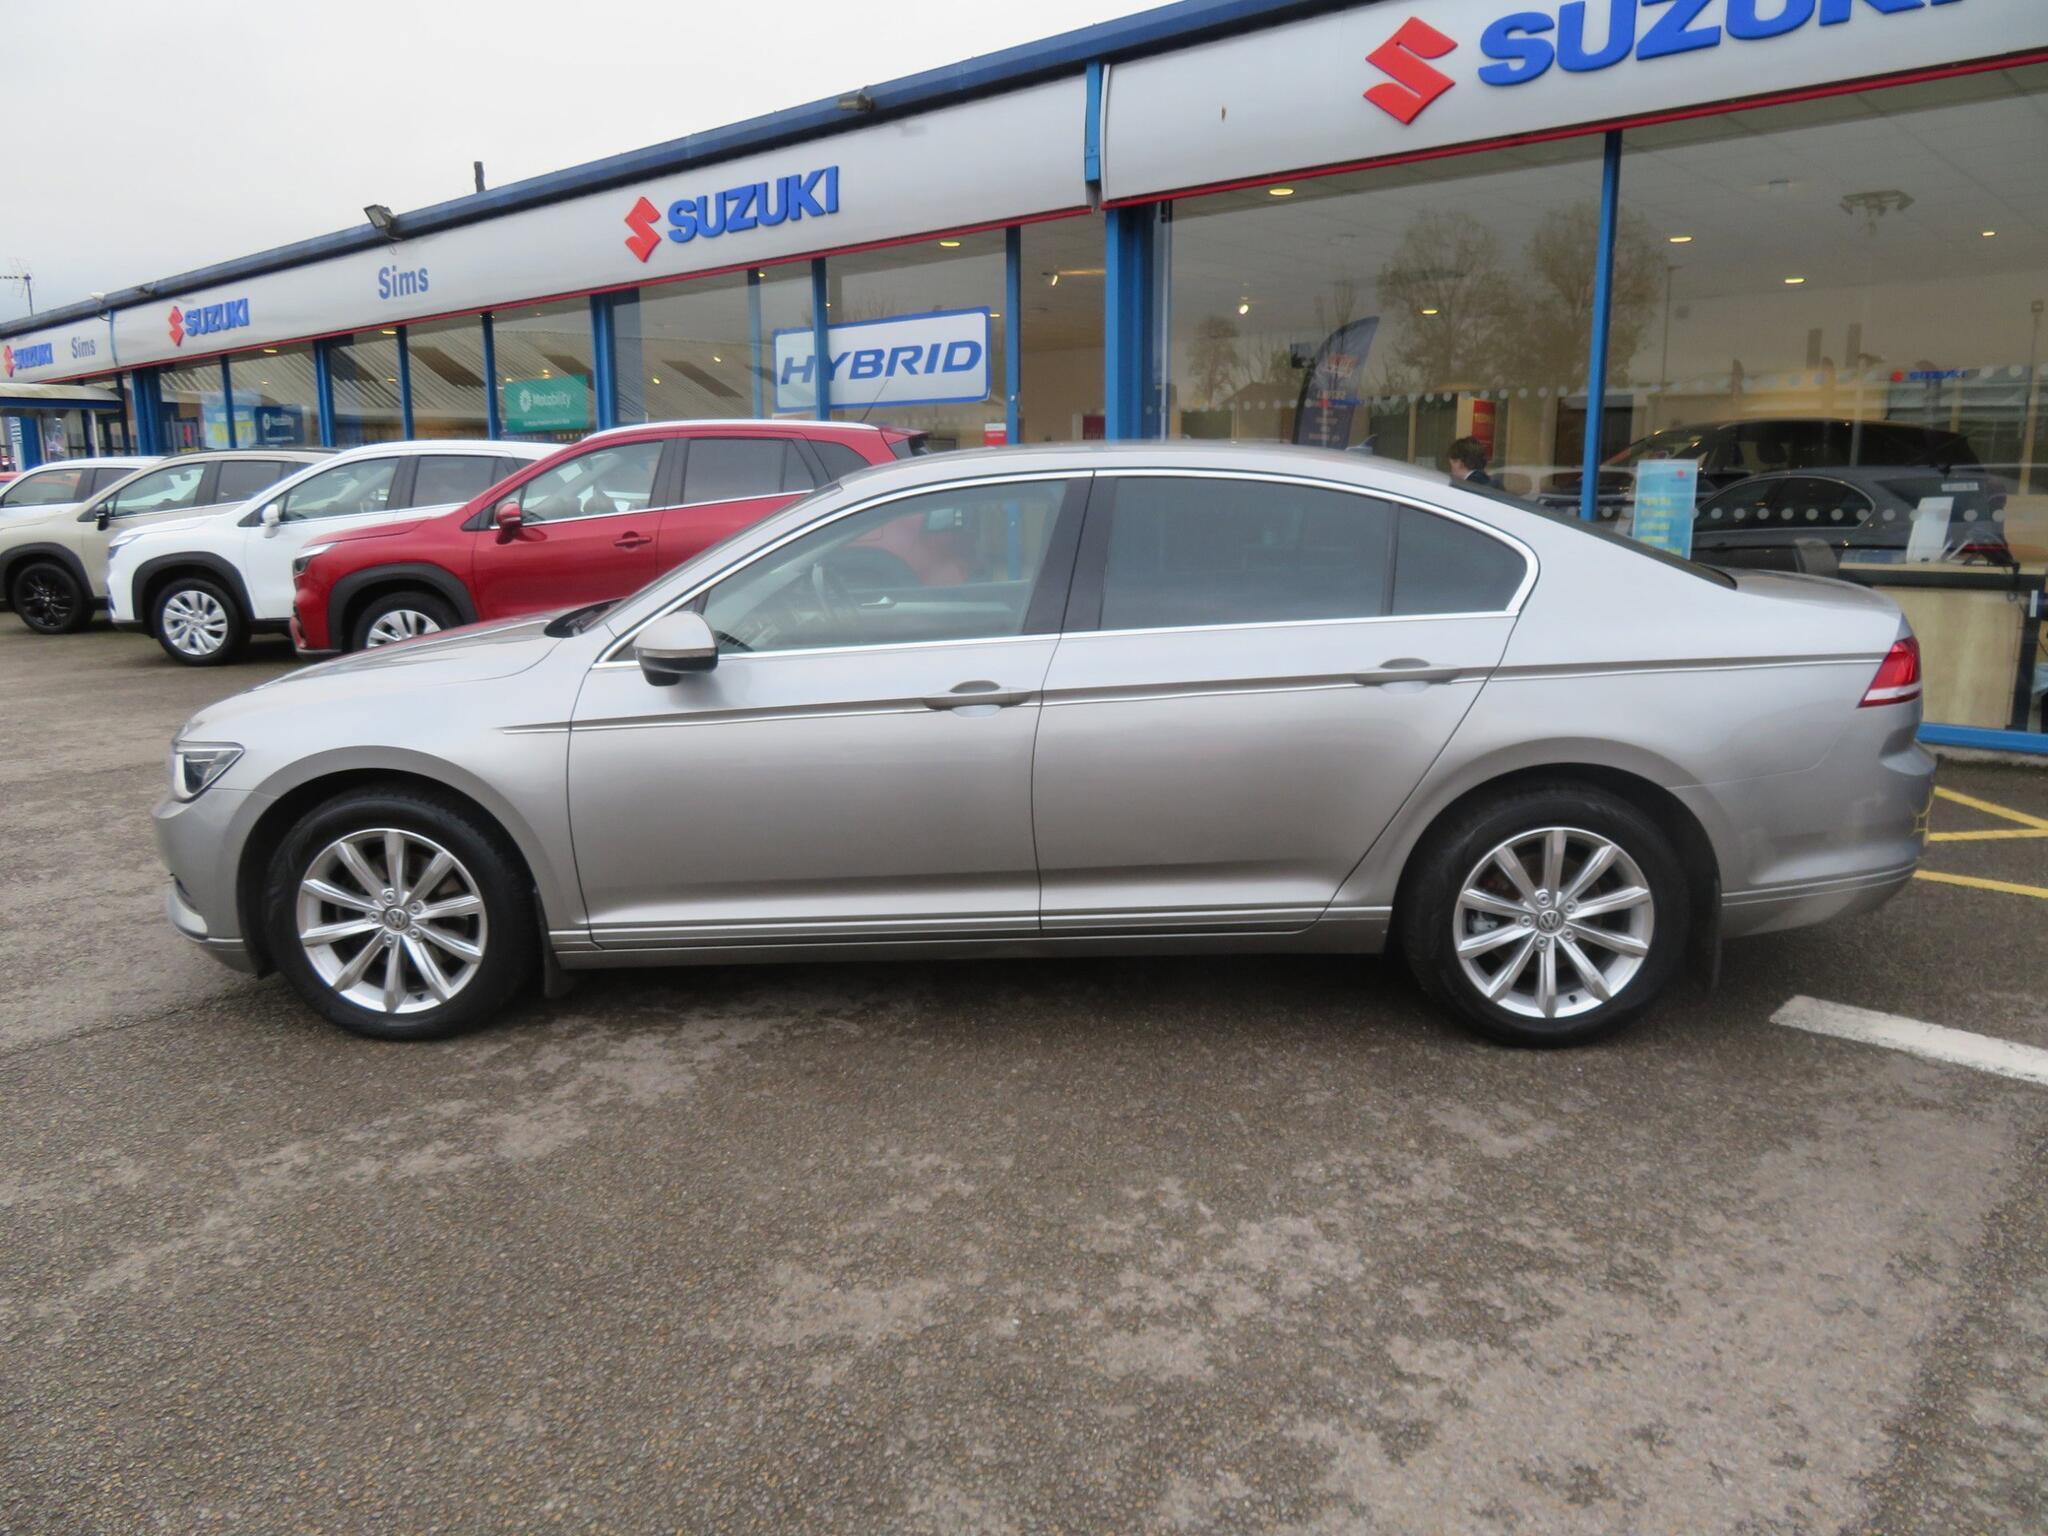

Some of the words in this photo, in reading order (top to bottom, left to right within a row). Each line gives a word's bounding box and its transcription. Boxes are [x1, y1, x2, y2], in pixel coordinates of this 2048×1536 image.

[1478, 0, 1963, 86] SUZU
[668, 166, 839, 244] SUZUKI
[378, 266, 429, 299] Sims
[184, 298, 249, 336] SUZUKI
[71, 337, 96, 359] Sims
[780, 340, 982, 385] HYBRID
